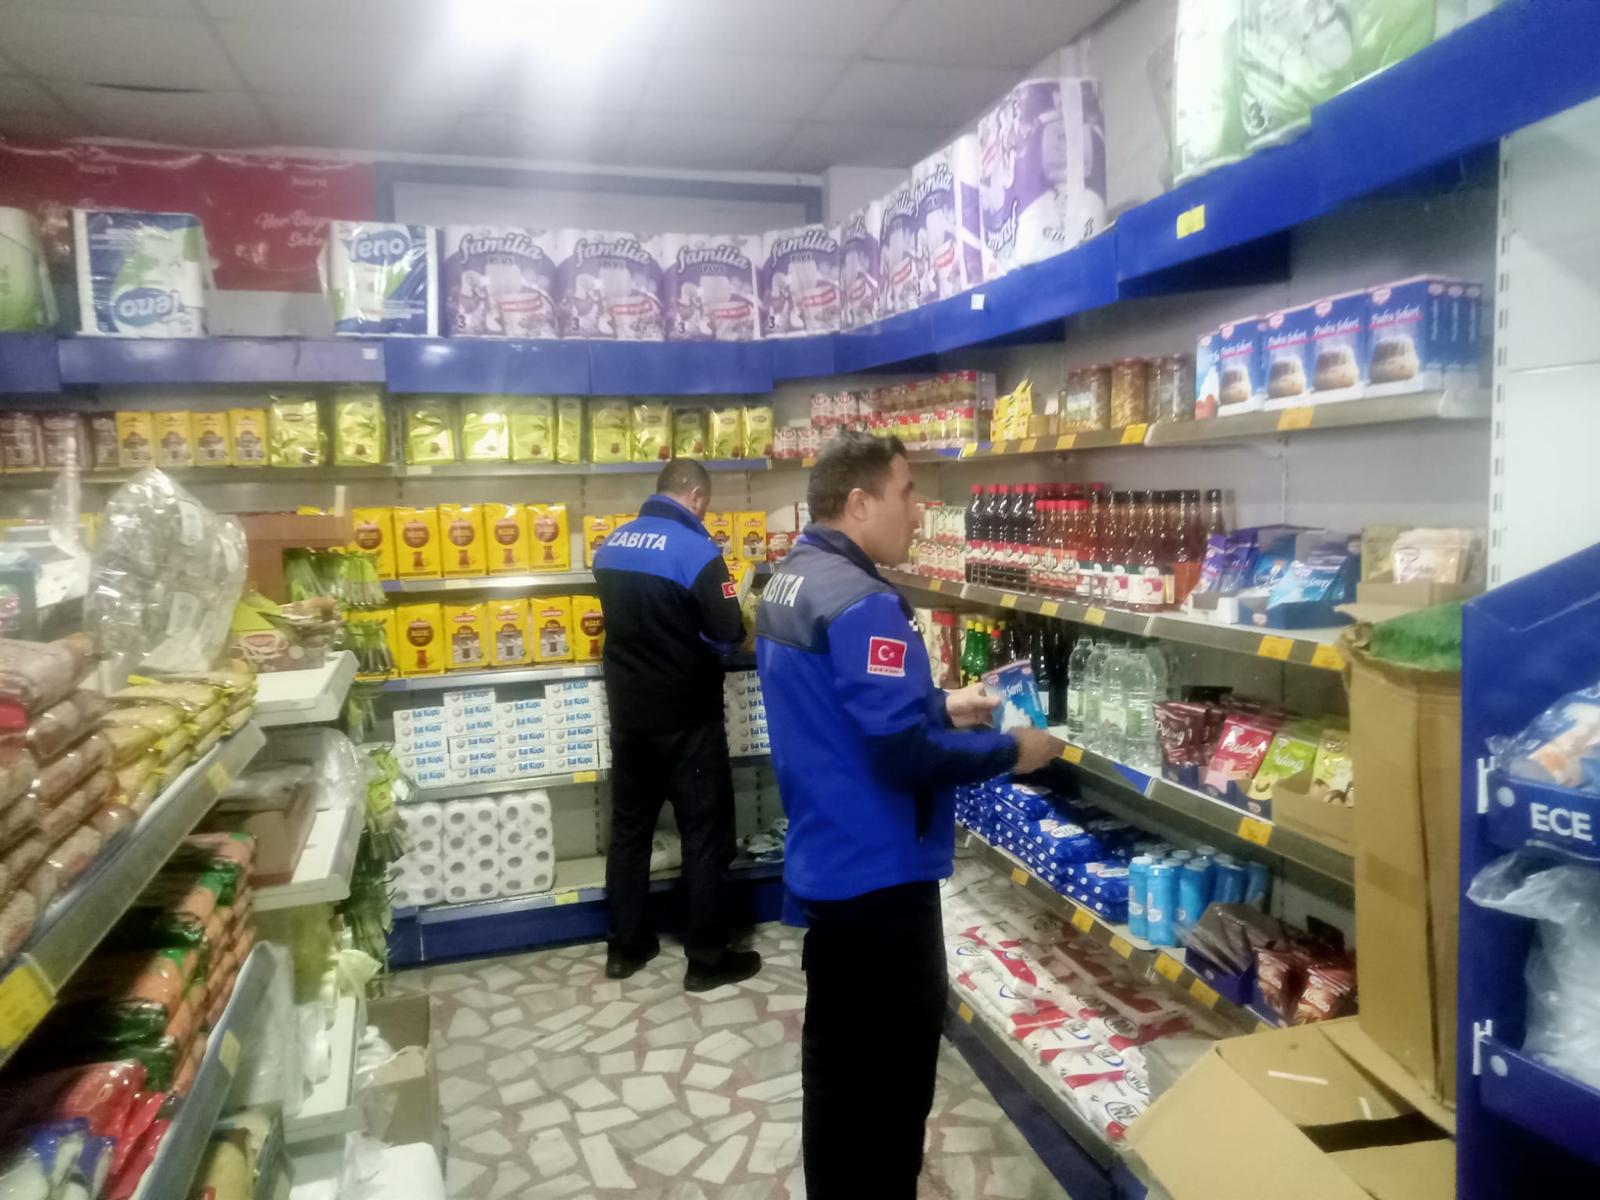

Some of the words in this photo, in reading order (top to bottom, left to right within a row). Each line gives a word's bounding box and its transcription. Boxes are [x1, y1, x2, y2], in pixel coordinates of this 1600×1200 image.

[351, 235, 407, 263] Teno
[459, 232, 544, 264] familia
[574, 237, 651, 267] familia
[677, 243, 750, 274] familia
[771, 228, 837, 267] familia
[607, 531, 667, 550] ZABITA
[1530, 802, 1593, 841] ECE
